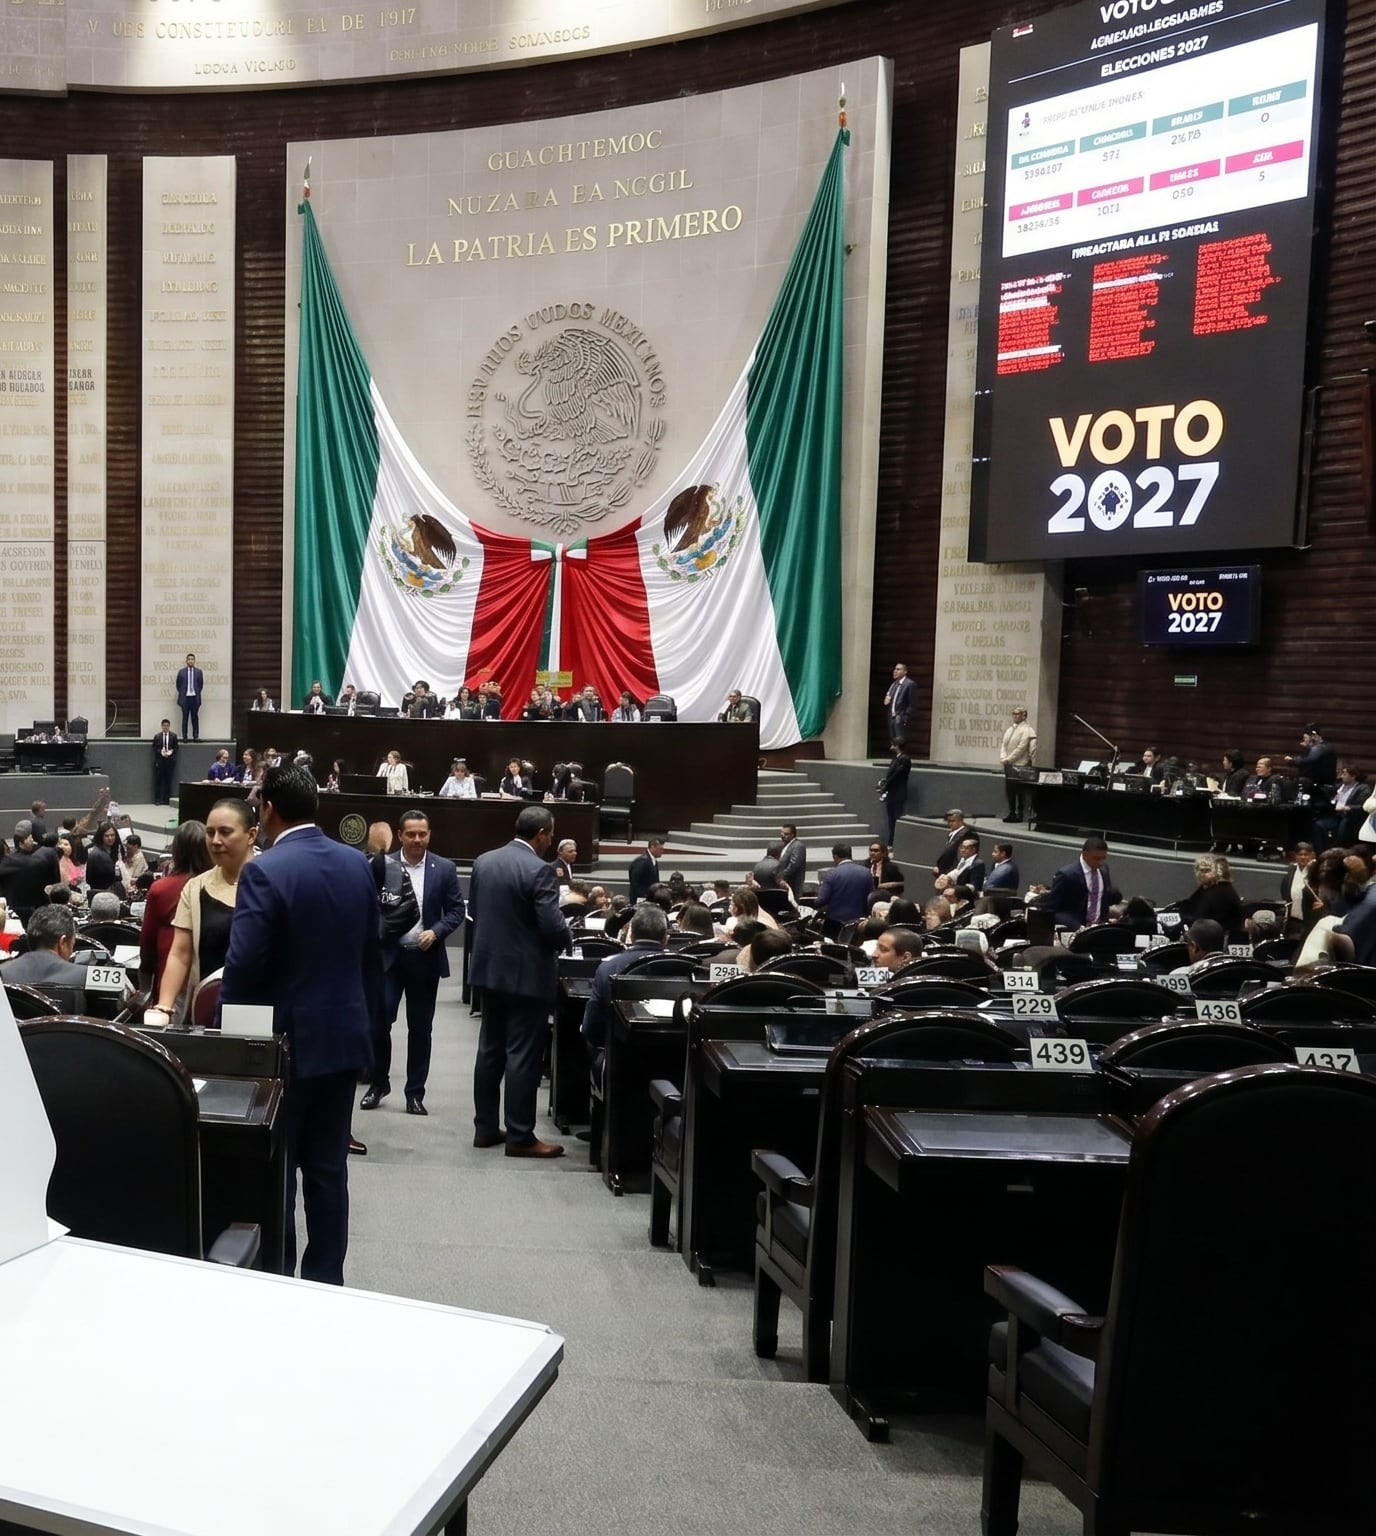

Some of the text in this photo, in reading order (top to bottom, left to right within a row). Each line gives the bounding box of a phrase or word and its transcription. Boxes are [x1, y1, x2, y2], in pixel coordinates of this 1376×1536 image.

[341, 14, 365, 31] DE
[380, 8, 416, 27] 1917
[1101, 35, 1209, 77] ELECCIONES 2027
[488, 129, 662, 171] GUACHTEMOC
[407, 205, 743, 267] LA PATRIA ES PRIMERO
[1049, 400, 1223, 468] VOTO
[1048, 461, 1220, 533] 2027
[1168, 592, 1223, 611] VOTO
[1168, 612, 1222, 632] 2027
[92, 968, 121, 984] 373
[1007, 976, 1034, 988] 314
[1016, 998, 1052, 1014] 229
[1201, 1005, 1237, 1020] 436
[1036, 1043, 1086, 1064] 439
